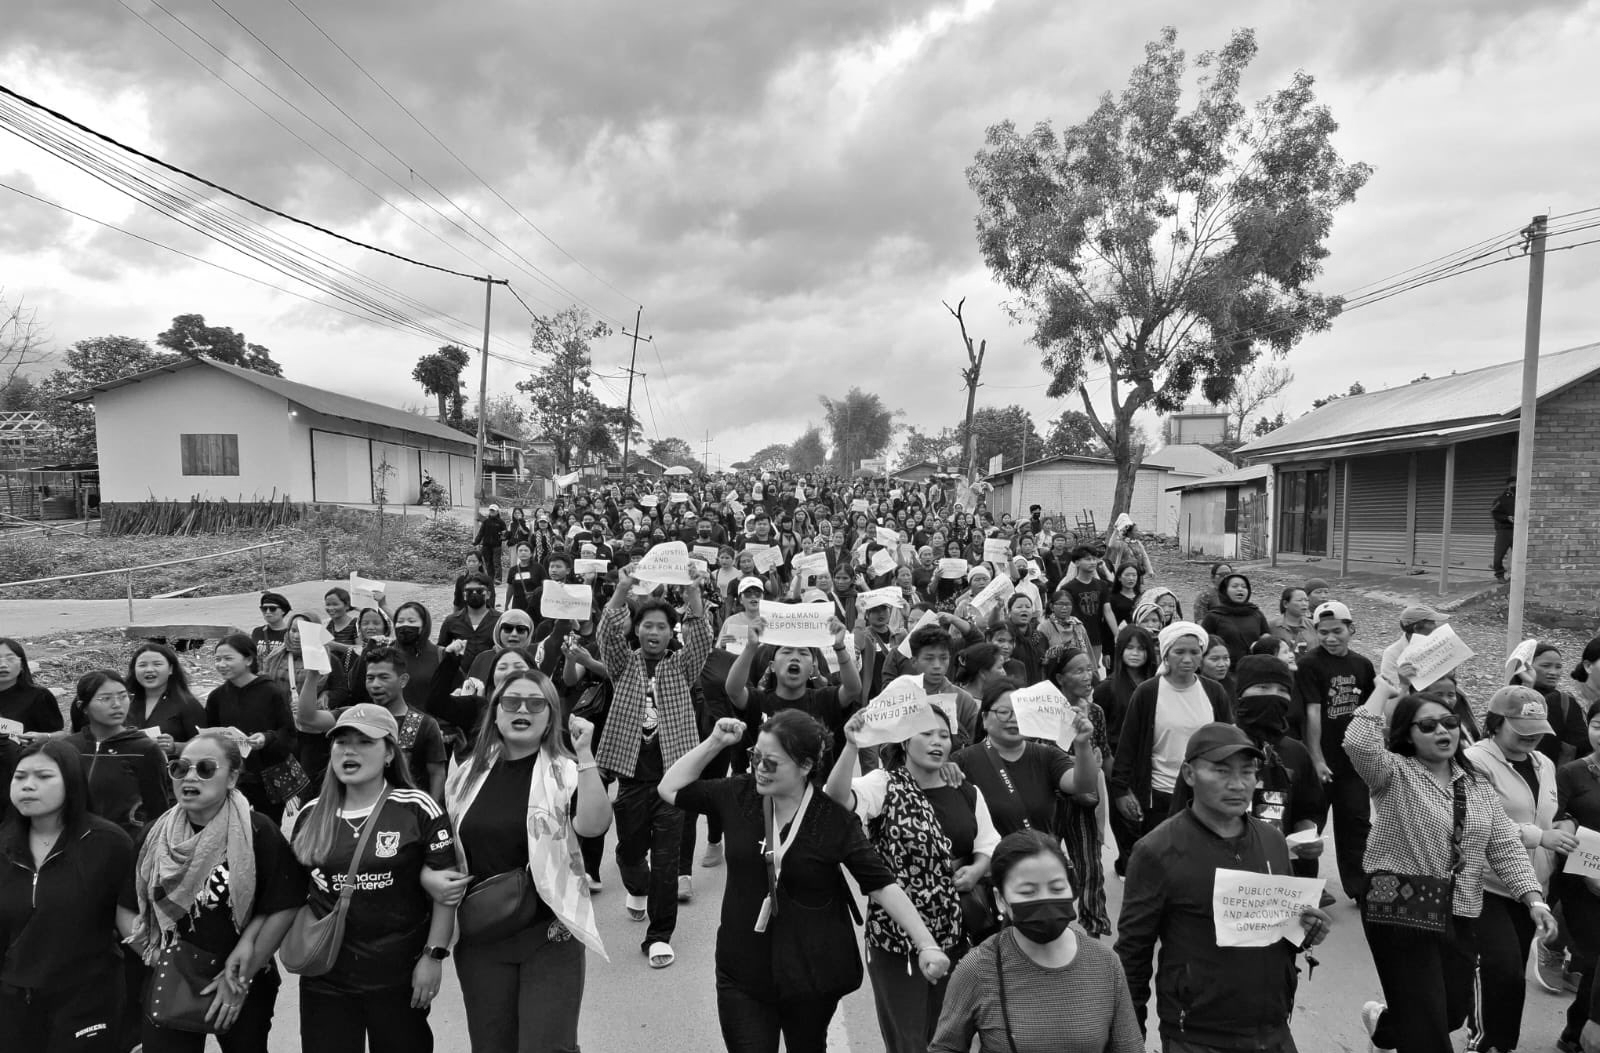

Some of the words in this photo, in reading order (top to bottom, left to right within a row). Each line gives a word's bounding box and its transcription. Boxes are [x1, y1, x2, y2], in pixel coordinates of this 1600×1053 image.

[898, 692, 916, 704] THE
[866, 708, 900, 722] DEMAN
[902, 704, 918, 716] WE
[1238, 885, 1272, 896] PUBLIC
[1274, 887, 1303, 899] TRUST
[1222, 896, 1266, 908] DEPENDS
[1223, 910, 1242, 919] AND
